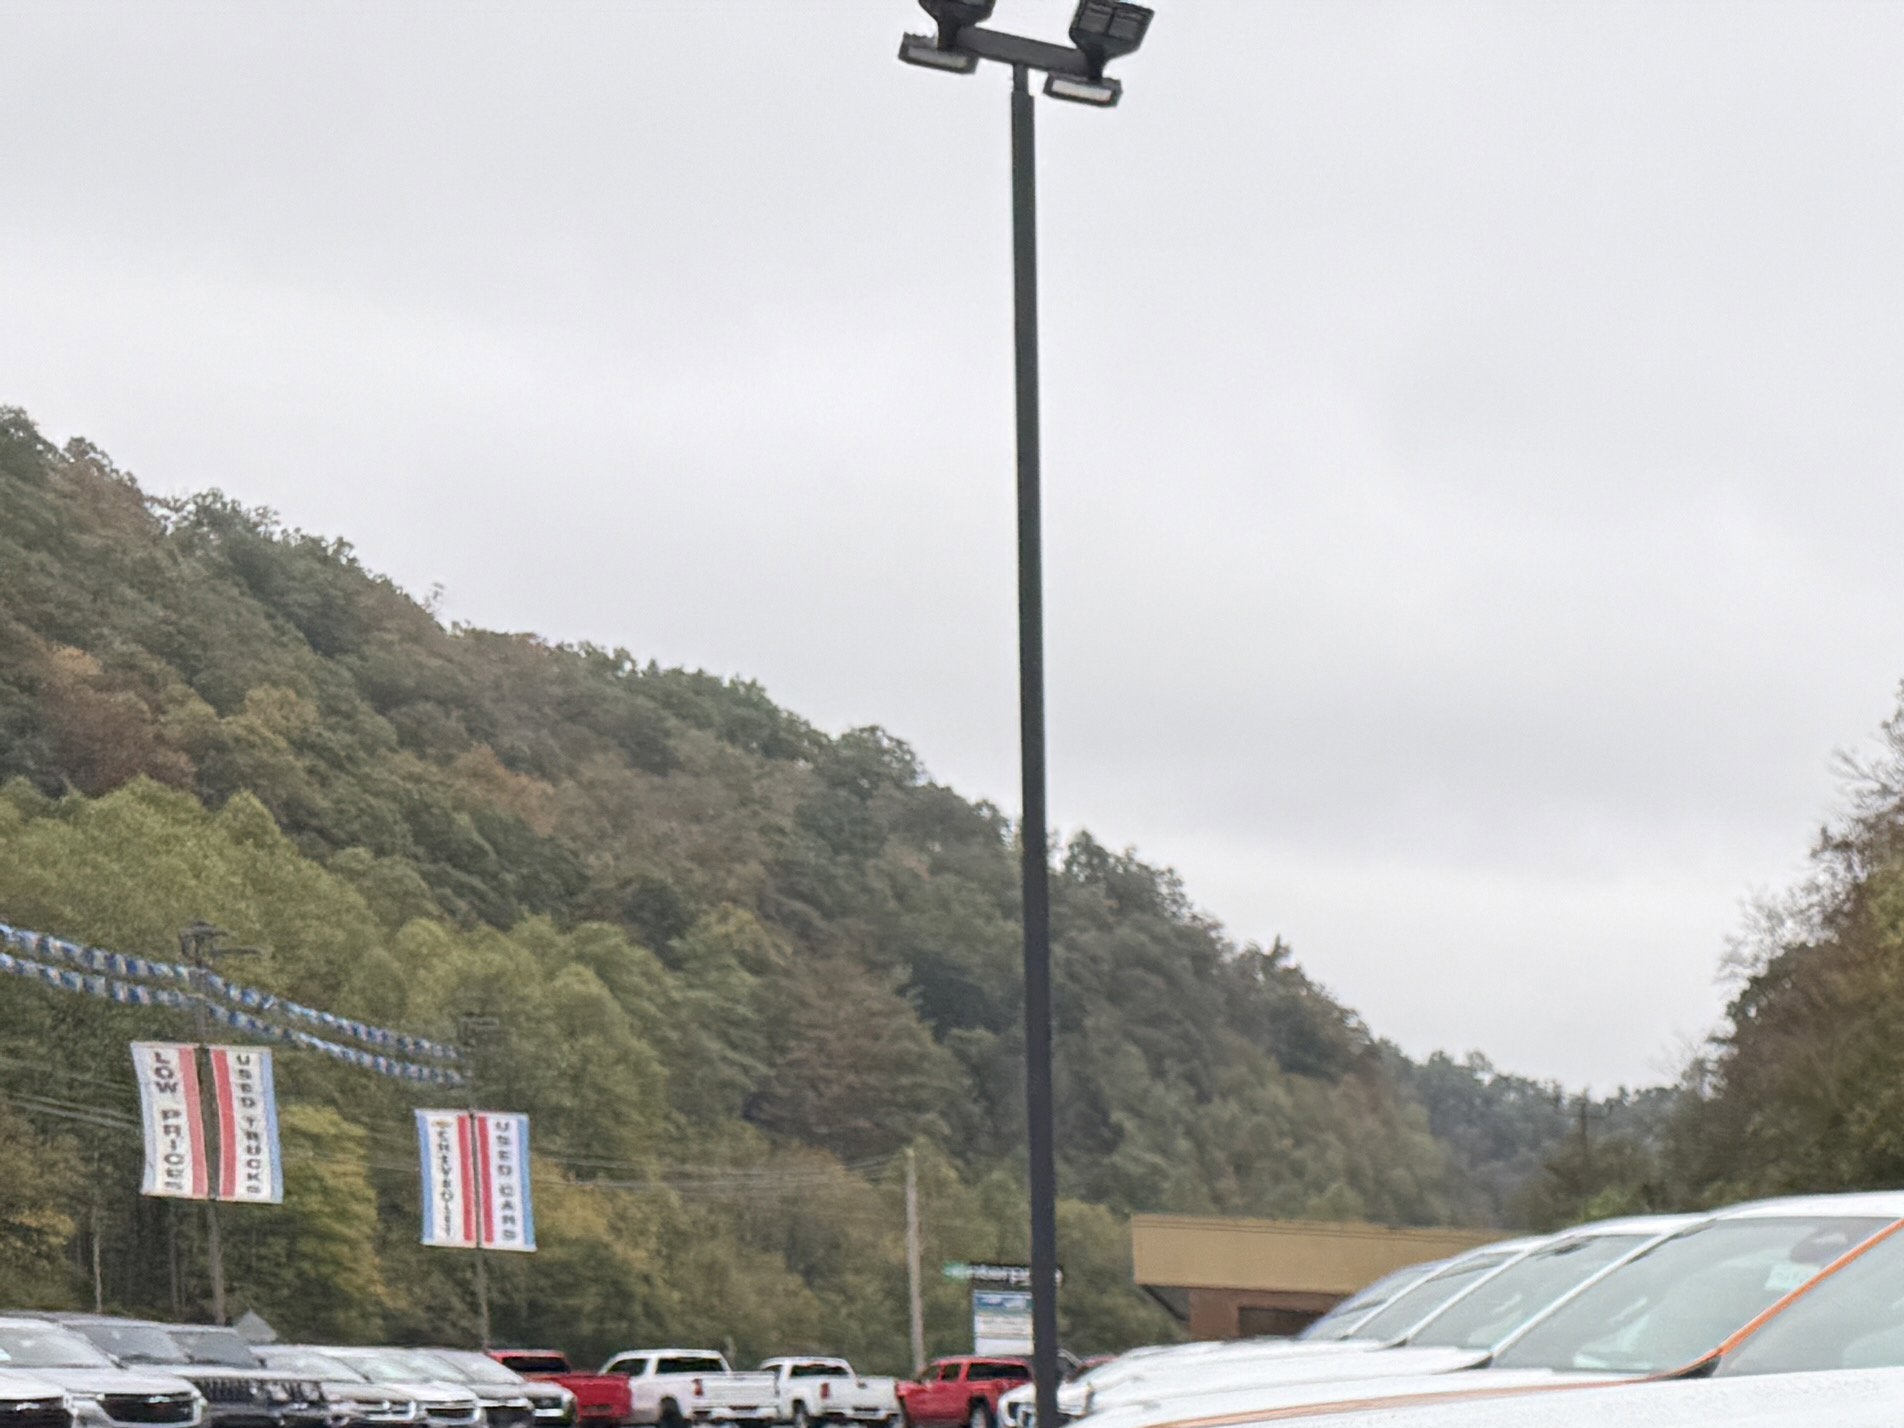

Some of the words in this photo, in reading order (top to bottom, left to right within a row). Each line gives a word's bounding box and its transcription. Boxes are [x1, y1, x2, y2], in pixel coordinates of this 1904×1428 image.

[154, 1051, 178, 1094] LOW
[236, 1053, 256, 1108] USED
[161, 1108, 184, 1191] PRICES
[243, 1115, 262, 1194] TRUCKS
[495, 1121, 512, 1177] USED
[498, 1183, 517, 1241] CARS
